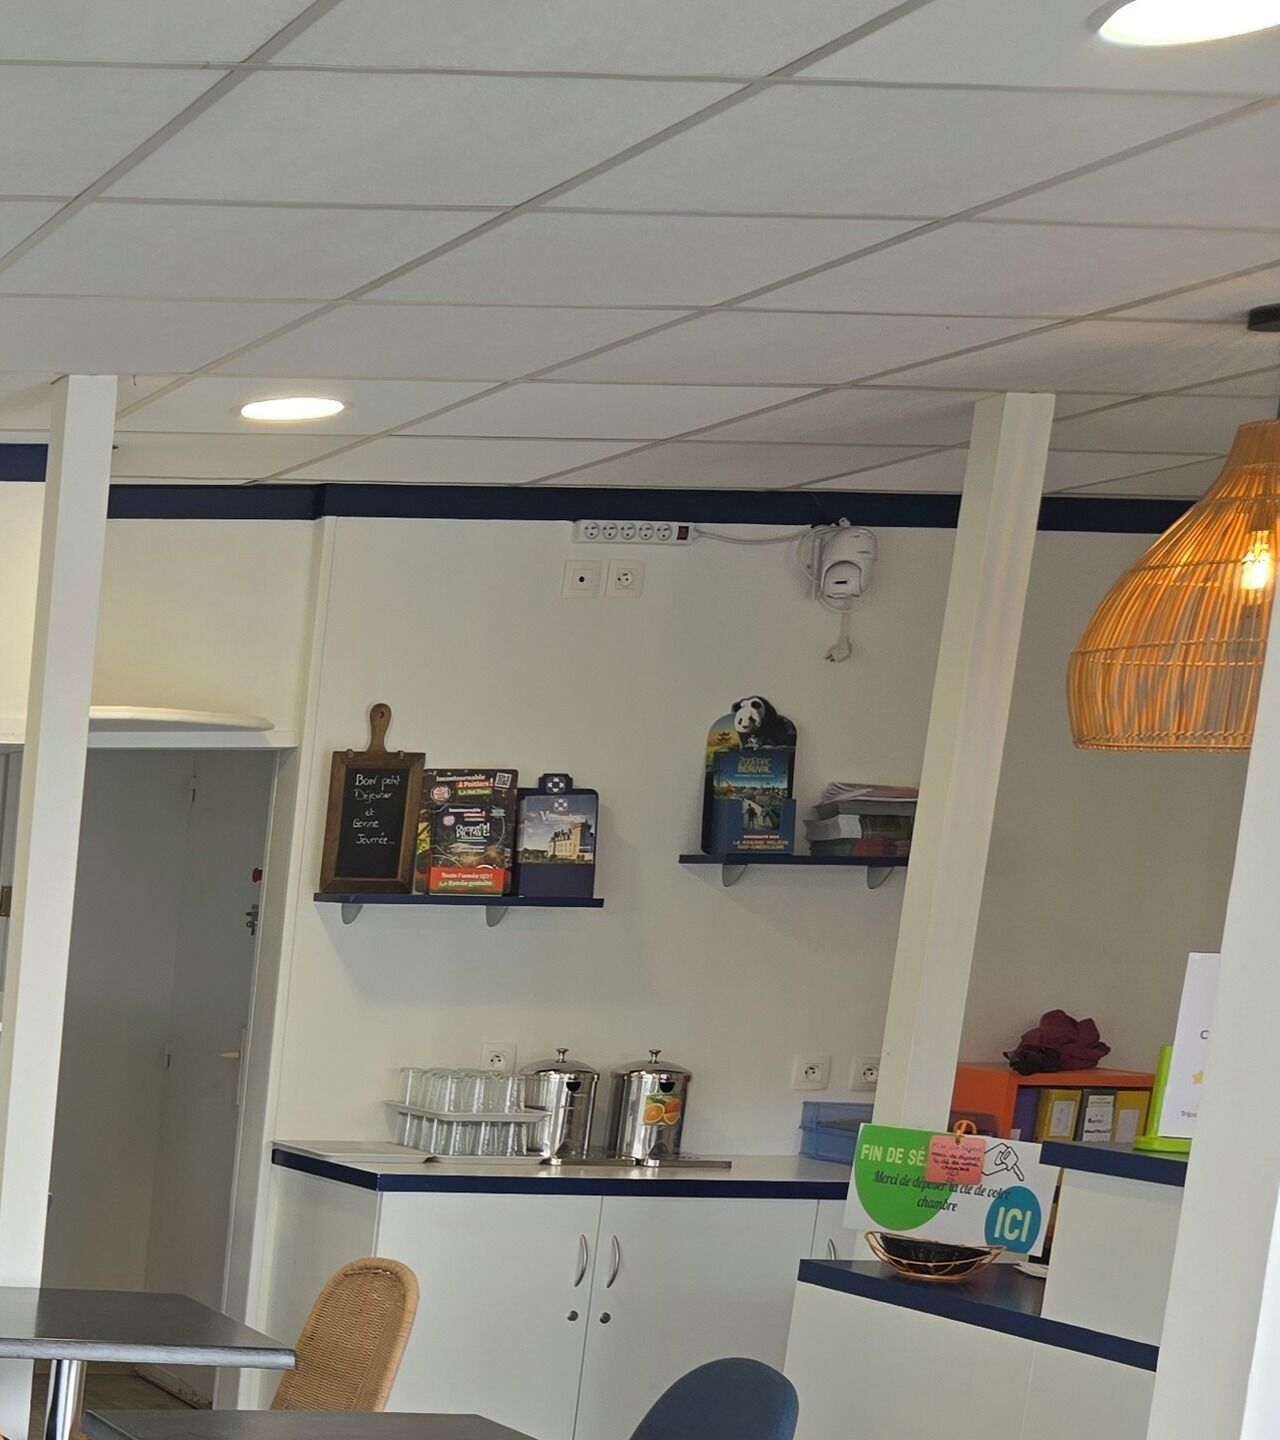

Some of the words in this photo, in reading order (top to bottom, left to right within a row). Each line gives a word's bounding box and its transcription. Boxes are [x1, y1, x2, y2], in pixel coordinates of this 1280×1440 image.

[860, 1144, 883, 1162] FIN
[886, 1147, 904, 1164] DE
[873, 1170, 899, 1185] Merci
[900, 1174, 910, 1187] de
[974, 1184, 986, 1197] de
[987, 1187, 1010, 1200] votre
[917, 1196, 958, 1212] chambre
[994, 1206, 1032, 1242] ICI
